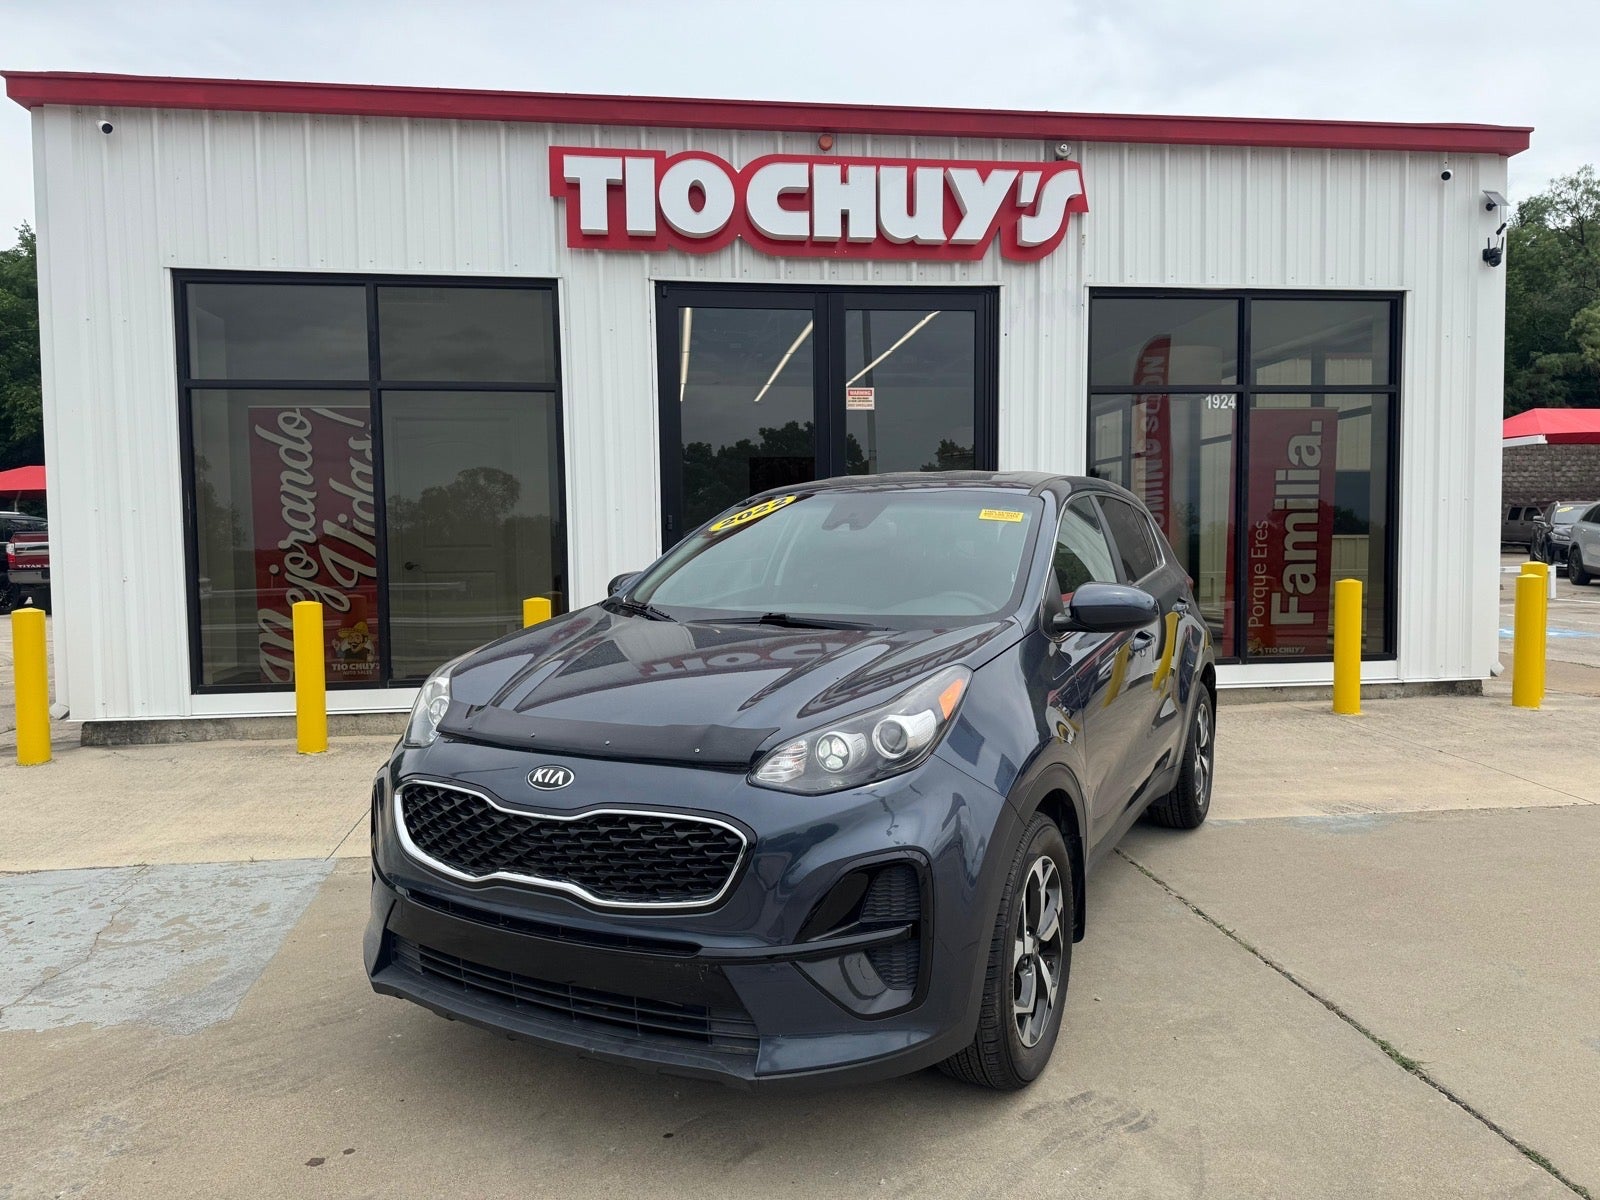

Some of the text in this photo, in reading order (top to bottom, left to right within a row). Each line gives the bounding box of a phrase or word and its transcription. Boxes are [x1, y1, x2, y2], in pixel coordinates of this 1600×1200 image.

[562, 154, 1083, 248] TIO CHUY'S
[1205, 393, 1237, 409] 1924
[719, 498, 787, 528] 2022
[1270, 420, 1323, 626] Familia.
[1248, 520, 1270, 628] Porque Eres
[331, 663, 348, 671] TIO
[532, 768, 565, 785] KIA
